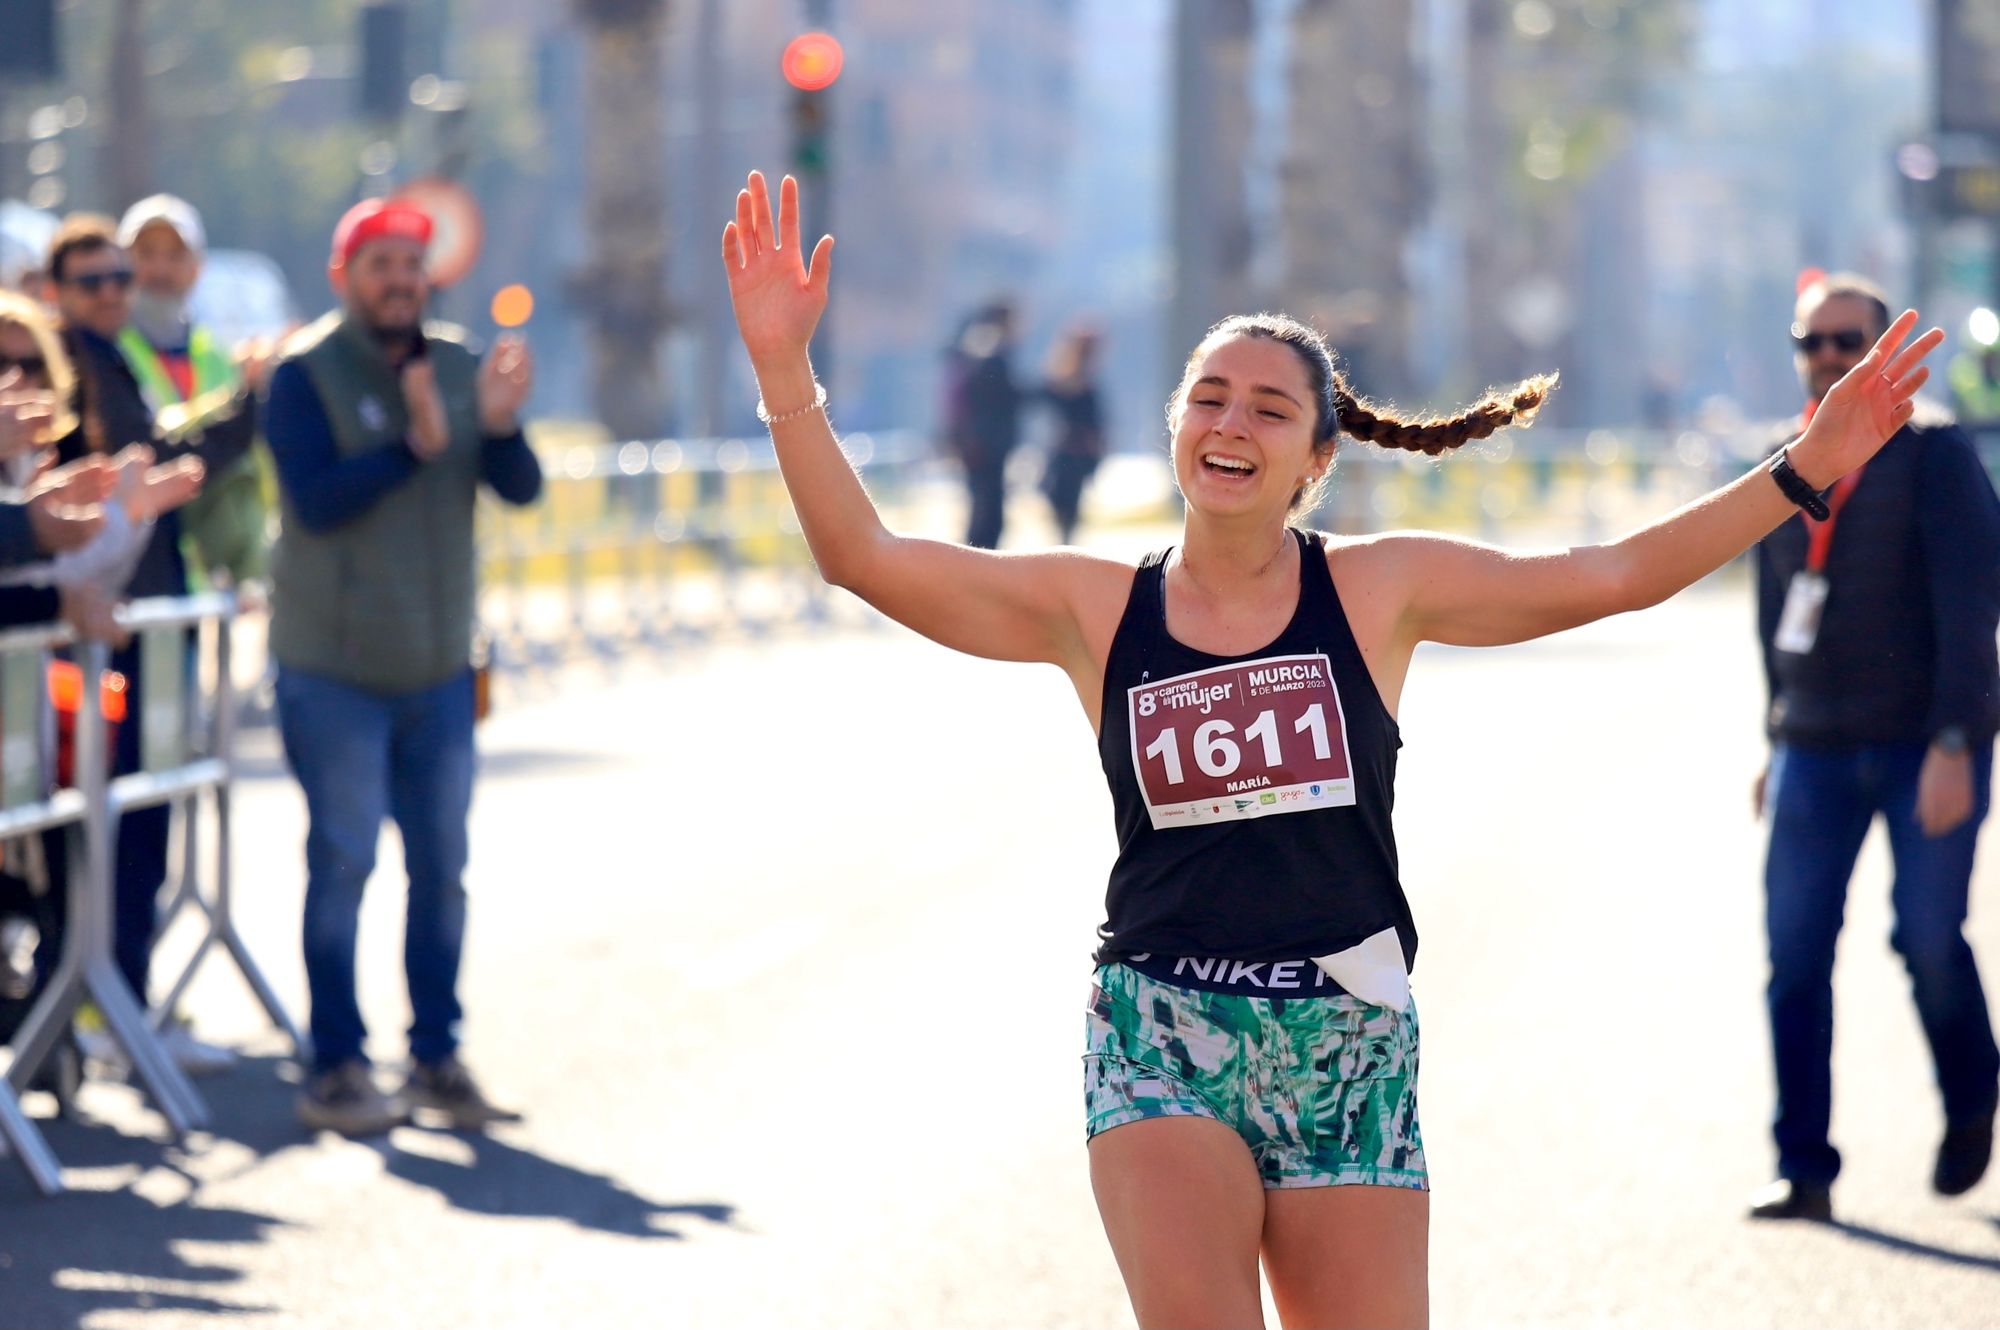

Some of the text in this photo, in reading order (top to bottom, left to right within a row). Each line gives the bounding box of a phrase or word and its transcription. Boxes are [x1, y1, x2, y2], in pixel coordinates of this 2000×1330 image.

[1248, 665, 1322, 687] MURCIA
[1159, 680, 1198, 697] carrera
[1171, 682, 1233, 714] mujer
[1250, 680, 1326, 697] 5 DE MARZO 2023
[1145, 703, 1331, 785] 1611
[1226, 775, 1271, 793] MARÍA
[1173, 957, 1306, 988] NIKE
